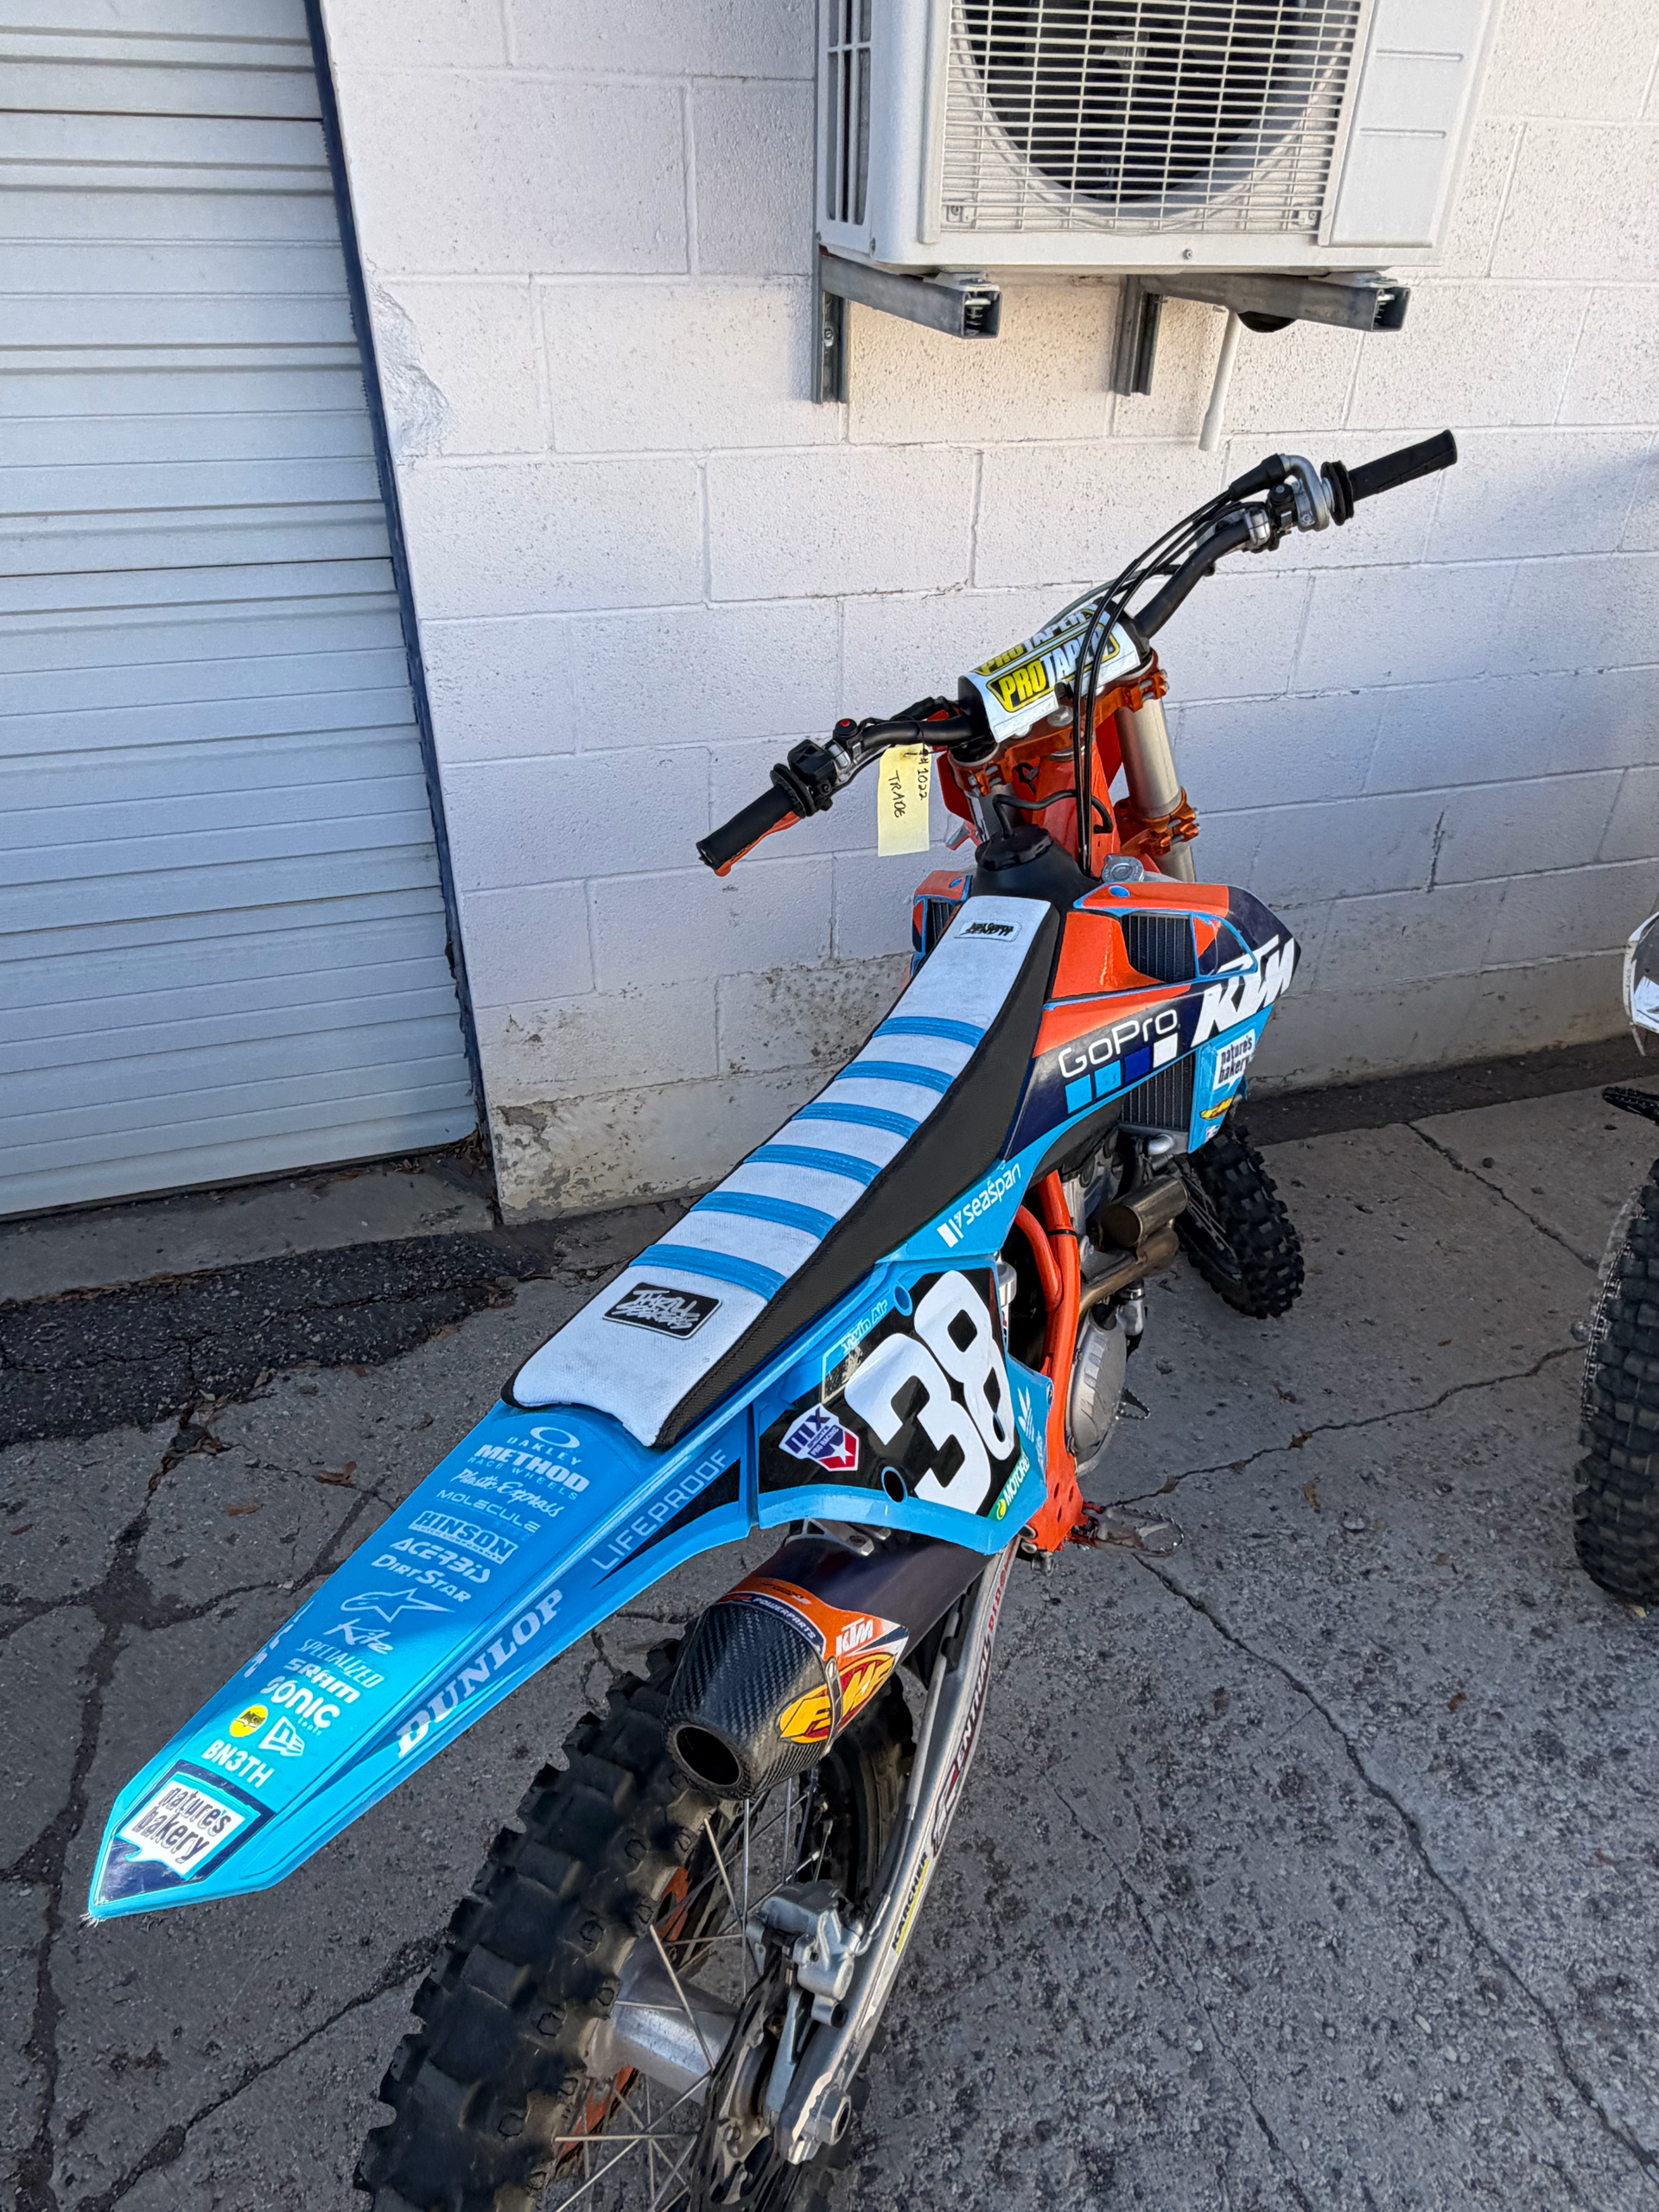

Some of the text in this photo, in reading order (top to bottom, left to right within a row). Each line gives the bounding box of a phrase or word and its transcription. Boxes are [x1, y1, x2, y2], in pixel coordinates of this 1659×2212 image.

[888, 770, 906, 817] TRADE
[1191, 934, 1294, 1047] KTM
[1058, 1009, 1178, 1078] GoPro
[1221, 1035, 1252, 1065] nature's
[963, 1163, 1020, 1225] seaspan
[872, 1300, 888, 1325] Air
[845, 1270, 1014, 1515] 38
[474, 1444, 590, 1492] METHOD
[507, 1437, 582, 1465] OAKLEY
[467, 1457, 579, 1500] RACE WHEELS
[435, 1490, 542, 1533] MOLECULE
[591, 1449, 730, 1570] LIFEPROOF
[414, 1512, 514, 1559] HINSON
[752, 1597, 817, 1640] POWERPARTS
[836, 1617, 874, 1657] KTM
[296, 1639, 385, 1688] SPECIALIZED
[397, 1589, 563, 1758] DUNLOP
[201, 1740, 275, 1788] BN3TH
[131, 1802, 210, 1865] bakery
[158, 1787, 232, 1836] nature's
